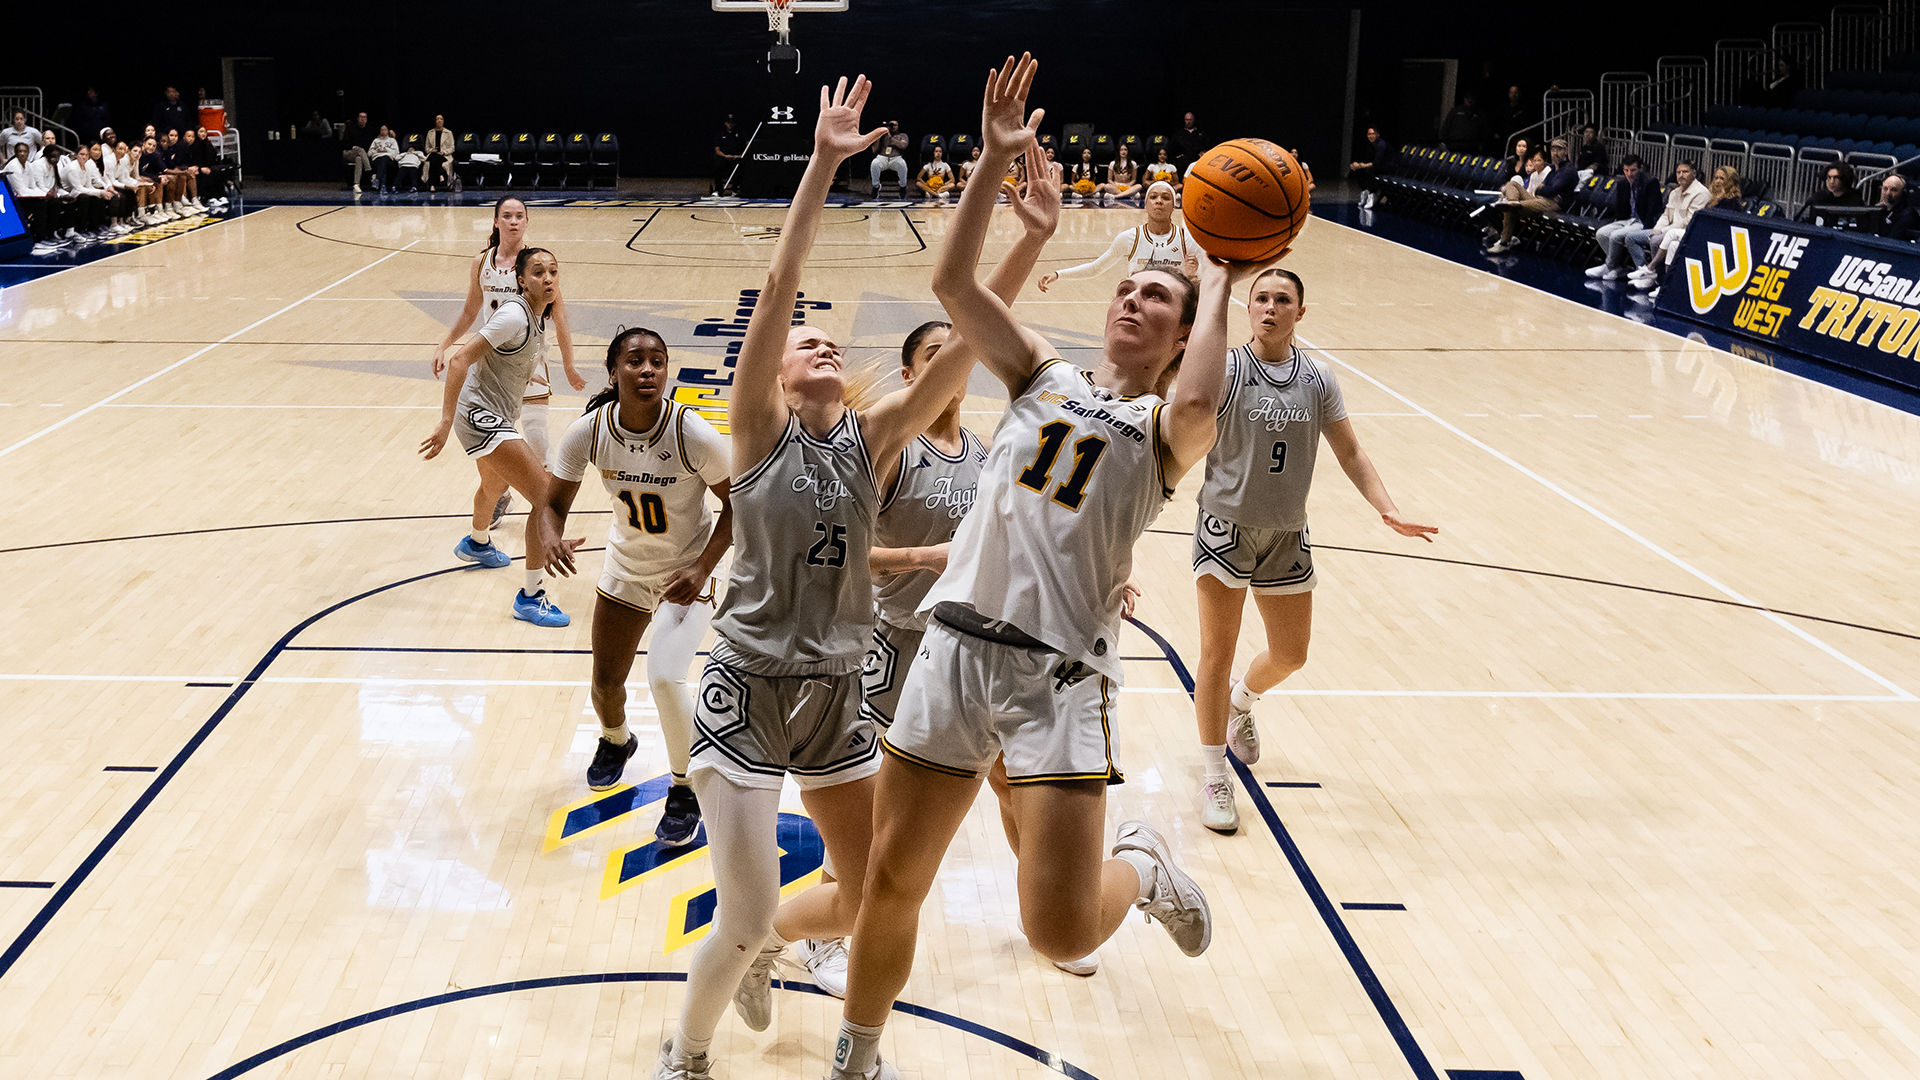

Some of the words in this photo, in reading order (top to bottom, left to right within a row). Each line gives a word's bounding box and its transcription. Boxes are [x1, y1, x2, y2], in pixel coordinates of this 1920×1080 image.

[1763, 232, 1810, 269] THE
[1746, 265, 1790, 301] BIG
[1733, 297, 1792, 337] WEST
[1248, 396, 1312, 432] Aggies
[1015, 418, 1109, 513] 11
[1268, 440, 1288, 475] 9
[617, 489, 668, 535] 10
[924, 476, 978, 520] Aggi
[805, 520, 847, 569] 25
